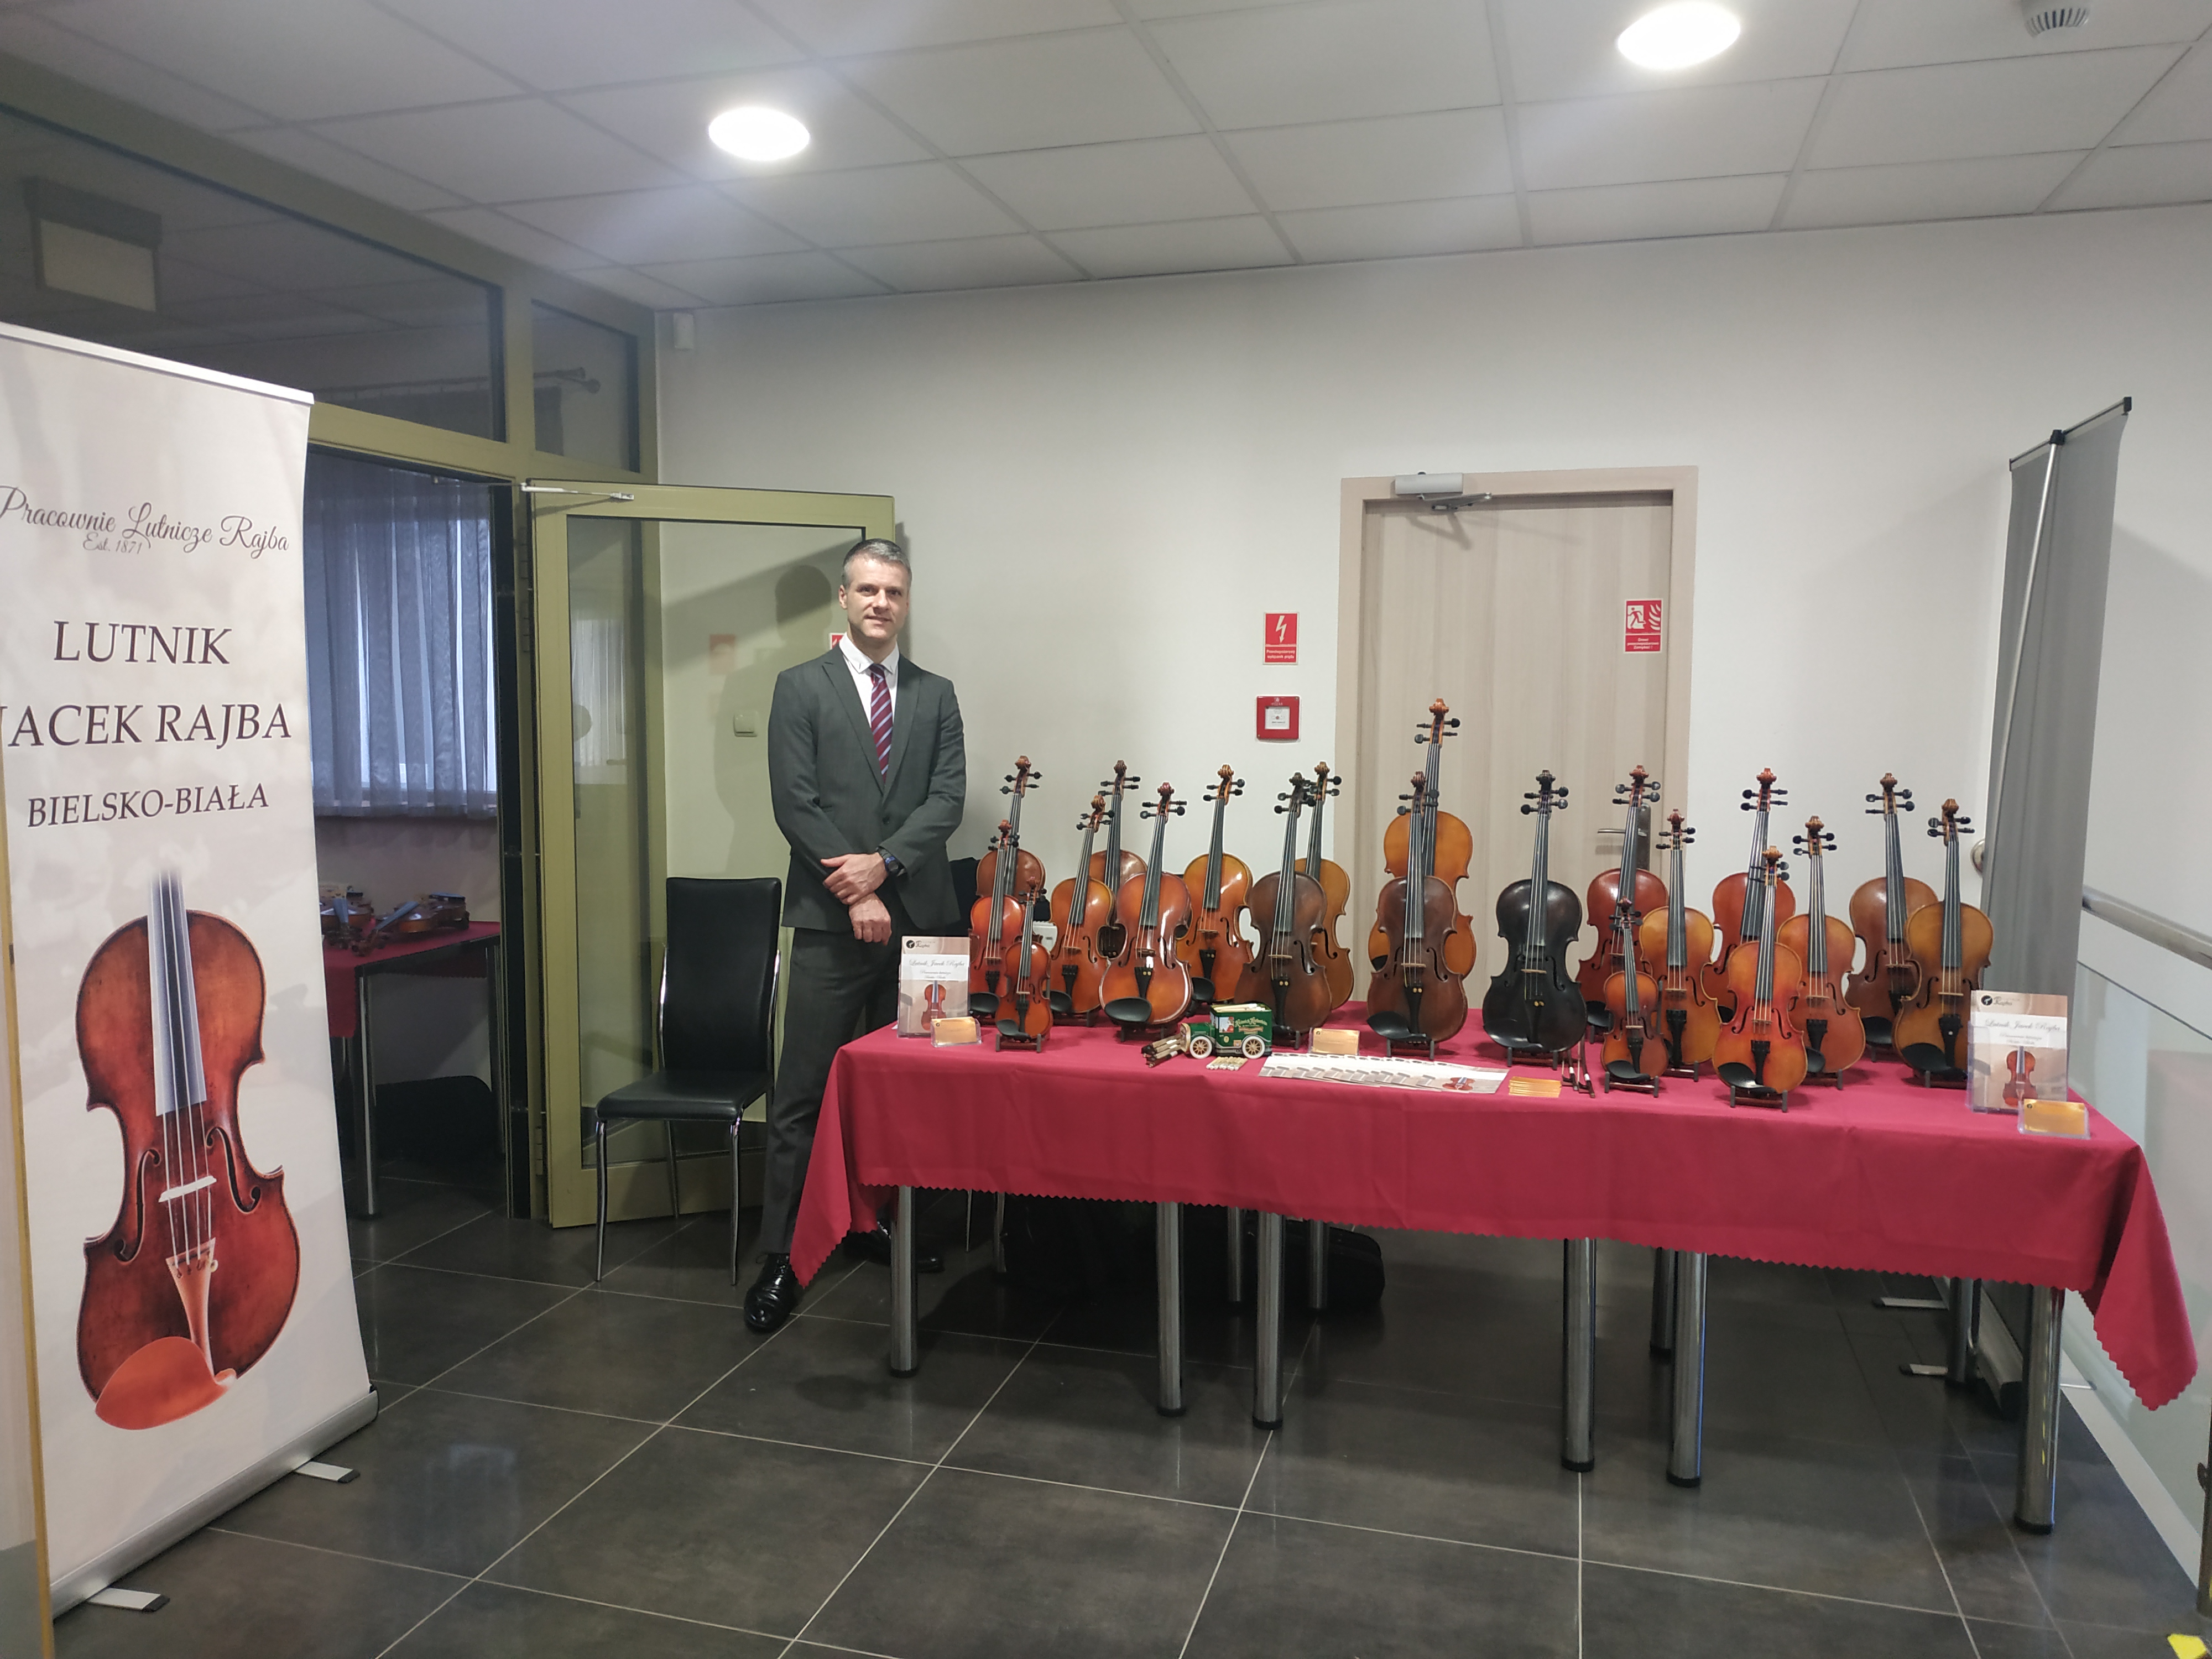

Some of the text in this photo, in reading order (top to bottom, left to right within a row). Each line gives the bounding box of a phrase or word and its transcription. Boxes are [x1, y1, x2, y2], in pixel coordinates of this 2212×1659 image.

[0, 485, 289, 560] Pracownie Lutnicze Rajba
[82, 531, 111, 551] Est.
[53, 620, 232, 665] LUTNIK
[155, 703, 292, 750] RAJBA
[27, 782, 269, 828] BIELSKO-BIAŁA
